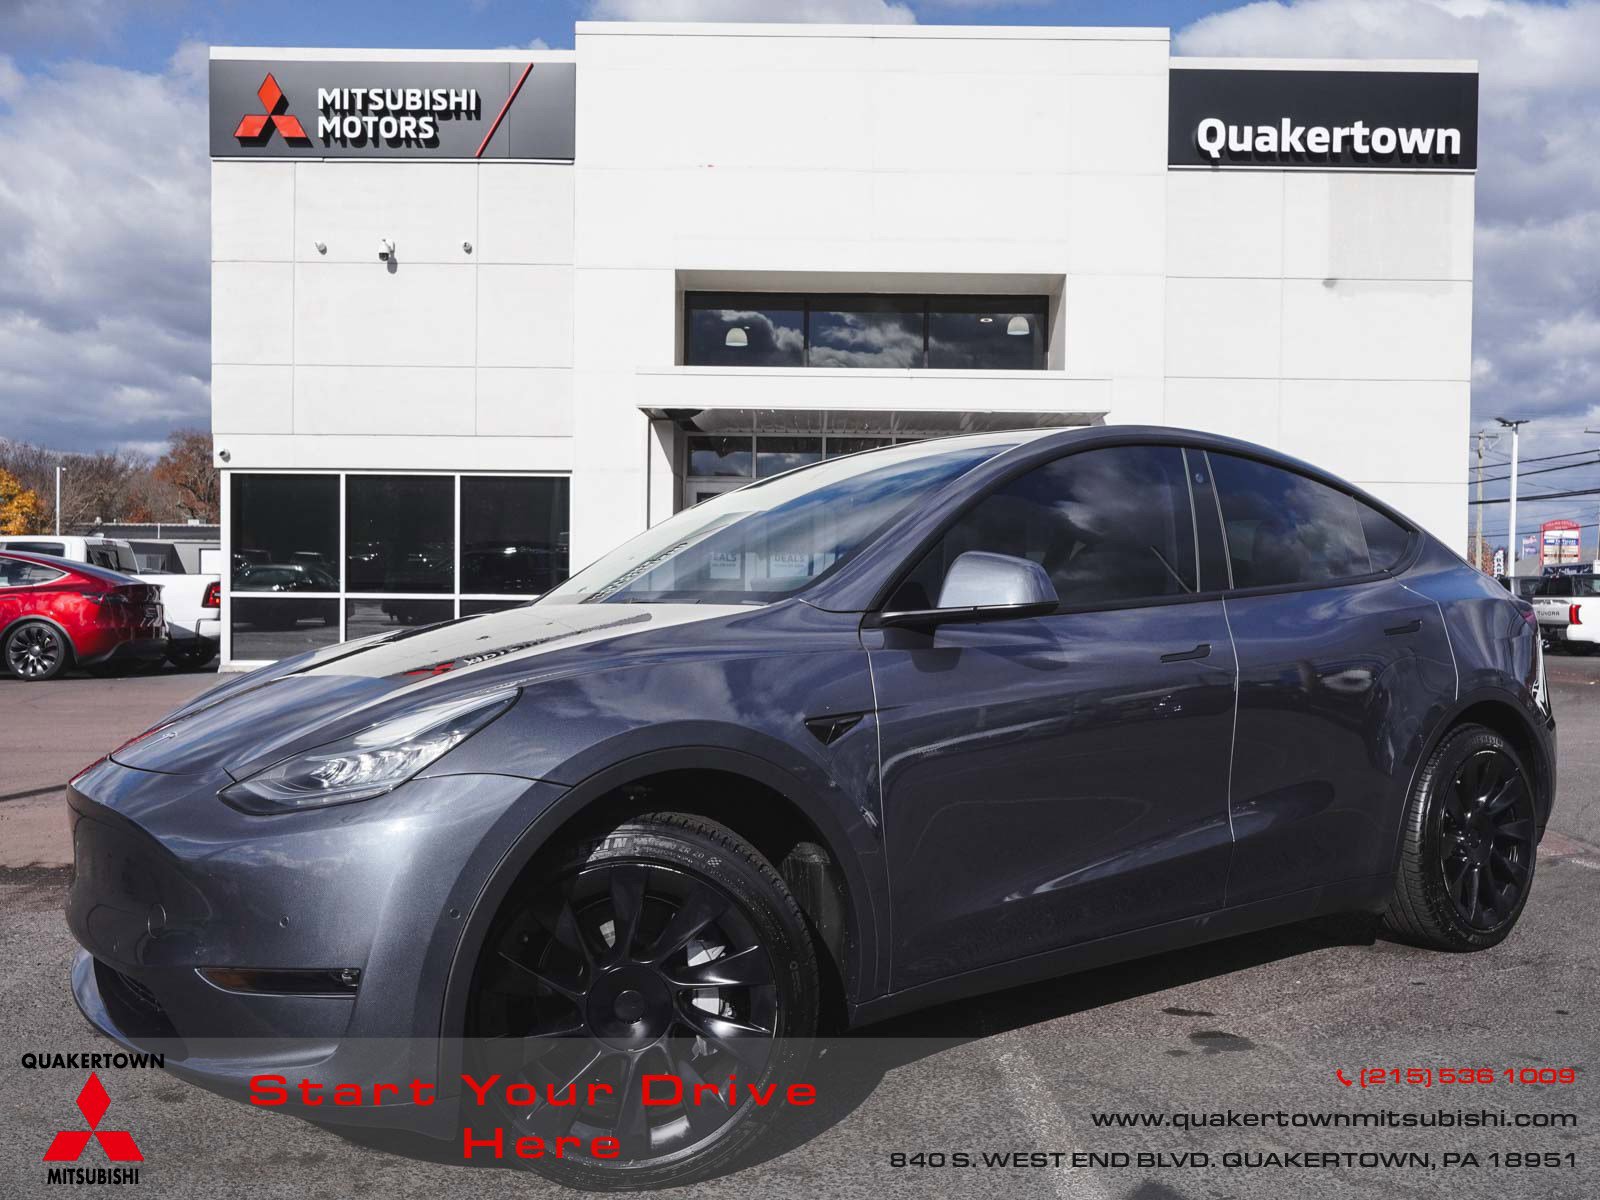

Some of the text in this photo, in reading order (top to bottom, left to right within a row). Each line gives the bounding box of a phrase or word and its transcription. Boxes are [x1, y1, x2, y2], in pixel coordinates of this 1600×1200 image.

[317, 88, 476, 111] MITSUBISHI
[317, 116, 434, 139] MOTORS
[1197, 117, 1461, 158] Quakertown
